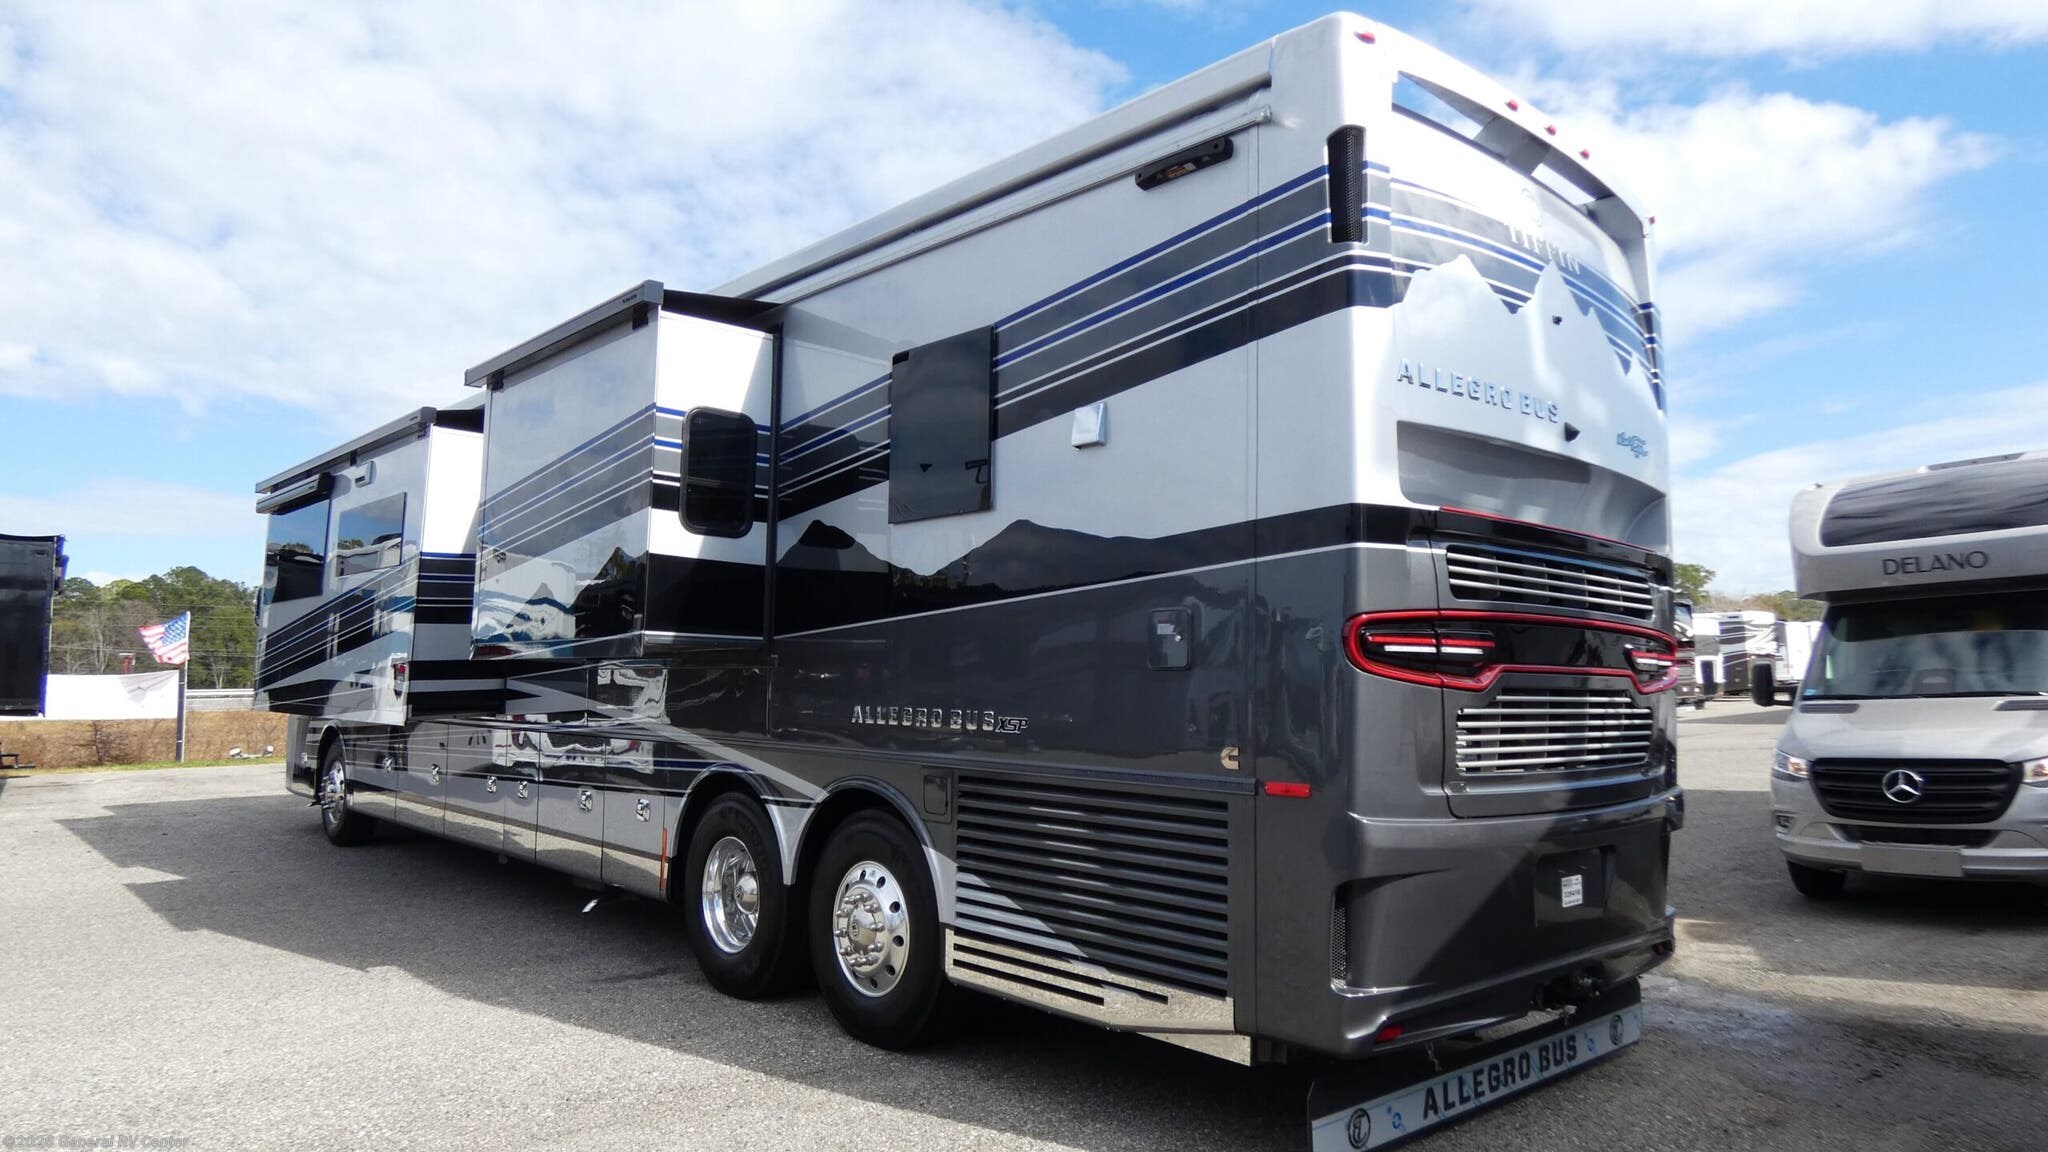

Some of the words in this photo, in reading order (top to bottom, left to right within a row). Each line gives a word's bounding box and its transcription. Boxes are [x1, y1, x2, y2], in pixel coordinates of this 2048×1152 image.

[1397, 358, 1513, 410] ALLEGRO
[1519, 391, 1560, 423] BUS
[1881, 550, 1990, 576] DELANO
[851, 705, 943, 728] ALLEGRO
[949, 709, 995, 731] BUS
[995, 716, 1029, 733] XSP
[1422, 1051, 1532, 1120] ALLEGRO
[1538, 1035, 1578, 1074] BUS
